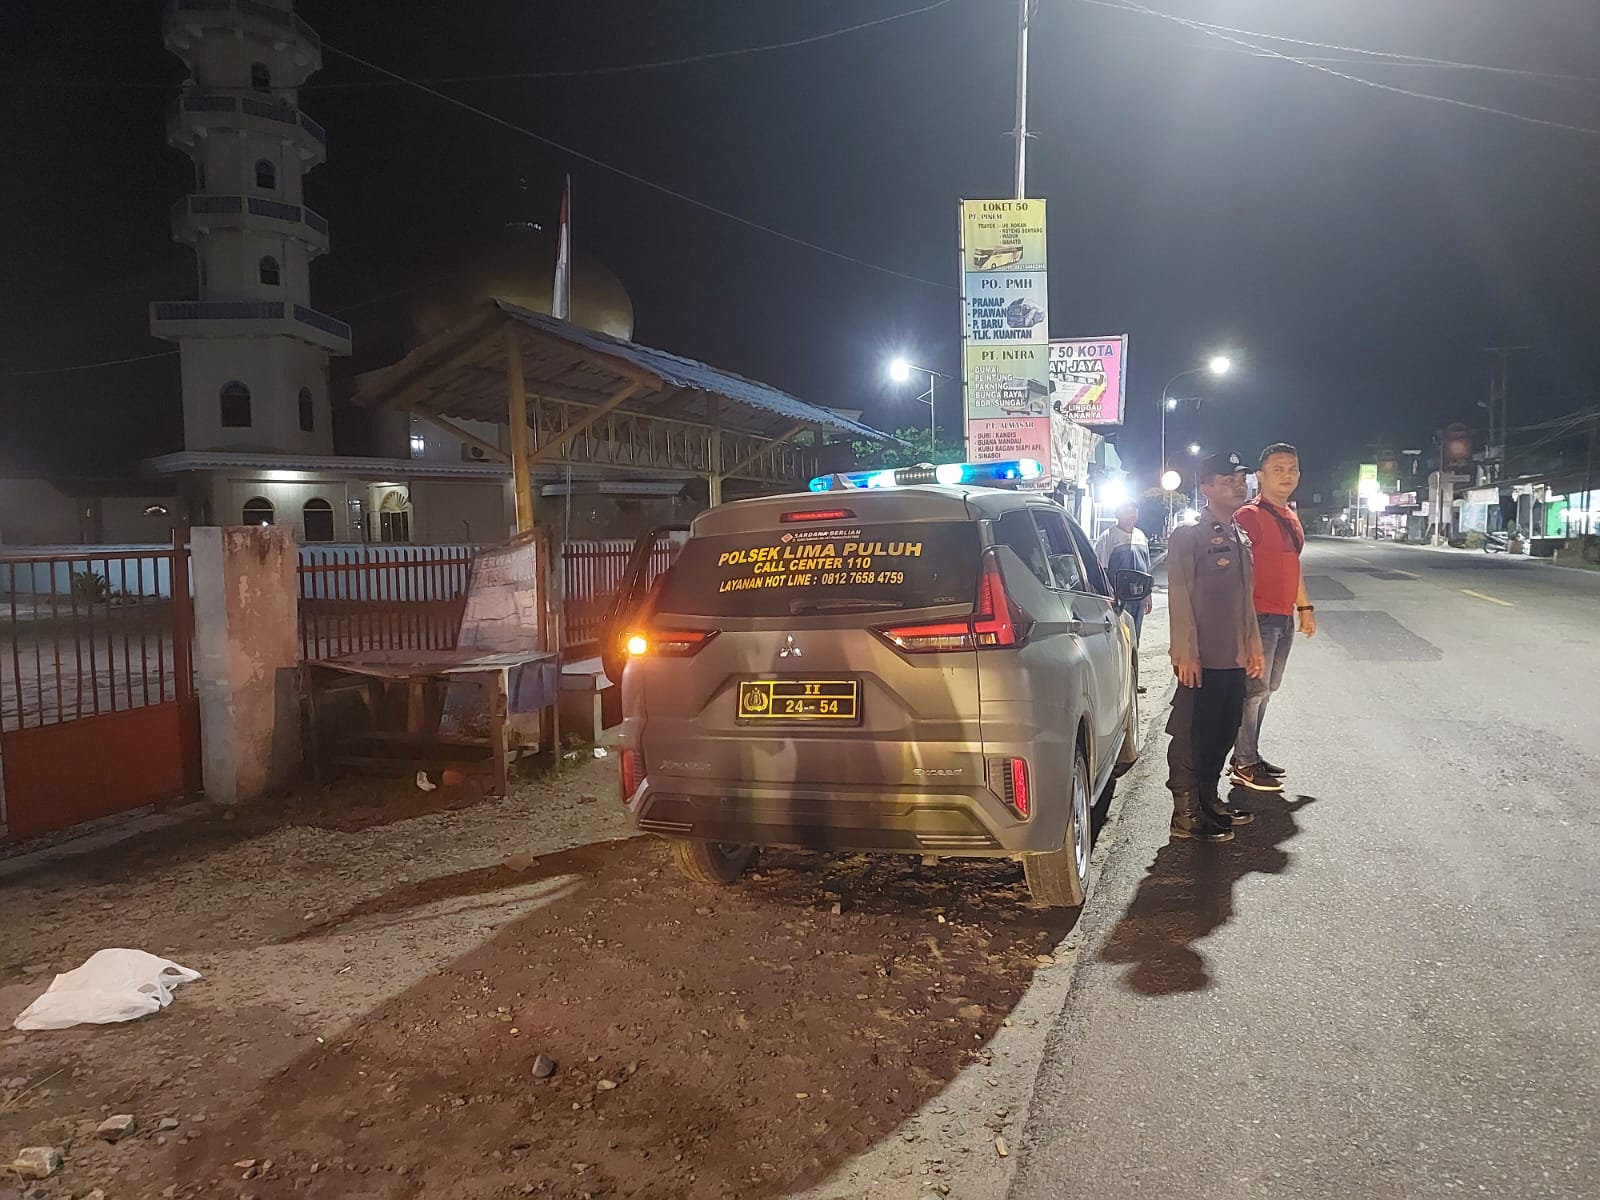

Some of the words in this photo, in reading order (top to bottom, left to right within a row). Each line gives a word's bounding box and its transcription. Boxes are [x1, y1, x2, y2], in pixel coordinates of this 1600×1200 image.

[983, 202, 1012, 211] LOKET
[1015, 202, 1028, 211] 50
[981, 279, 1001, 289] PO.
[1006, 278, 1032, 289] PMH
[972, 297, 1005, 307] PRANAP
[972, 319, 980, 329] P.
[981, 319, 1003, 328] BARU
[972, 330, 991, 340] TLK.
[993, 329, 1032, 339] KUANTAN
[981, 351, 999, 361] PT.
[1002, 350, 1035, 360] INTRA
[1058, 346, 1074, 358] 50
[1077, 344, 1114, 357] KOTA
[1069, 359, 1104, 373] JAYA
[975, 382, 1009, 391] PAKNING
[975, 391, 1001, 399] BUNGA
[1003, 390, 1023, 398] RAYA
[718, 546, 781, 567] POLSEK
[783, 543, 836, 559] LIMA
[842, 542, 923, 557] PULUH
[754, 561, 786, 574] CALL
[789, 557, 843, 571] CENTER
[847, 556, 871, 569] 110
[719, 576, 763, 593] LAYANAN
[764, 574, 787, 588] HOT
[821, 573, 847, 585] 0812
[849, 571, 875, 584] 7658
[877, 571, 904, 584] 4759
[804, 684, 821, 694] II
[820, 700, 838, 713] 54
